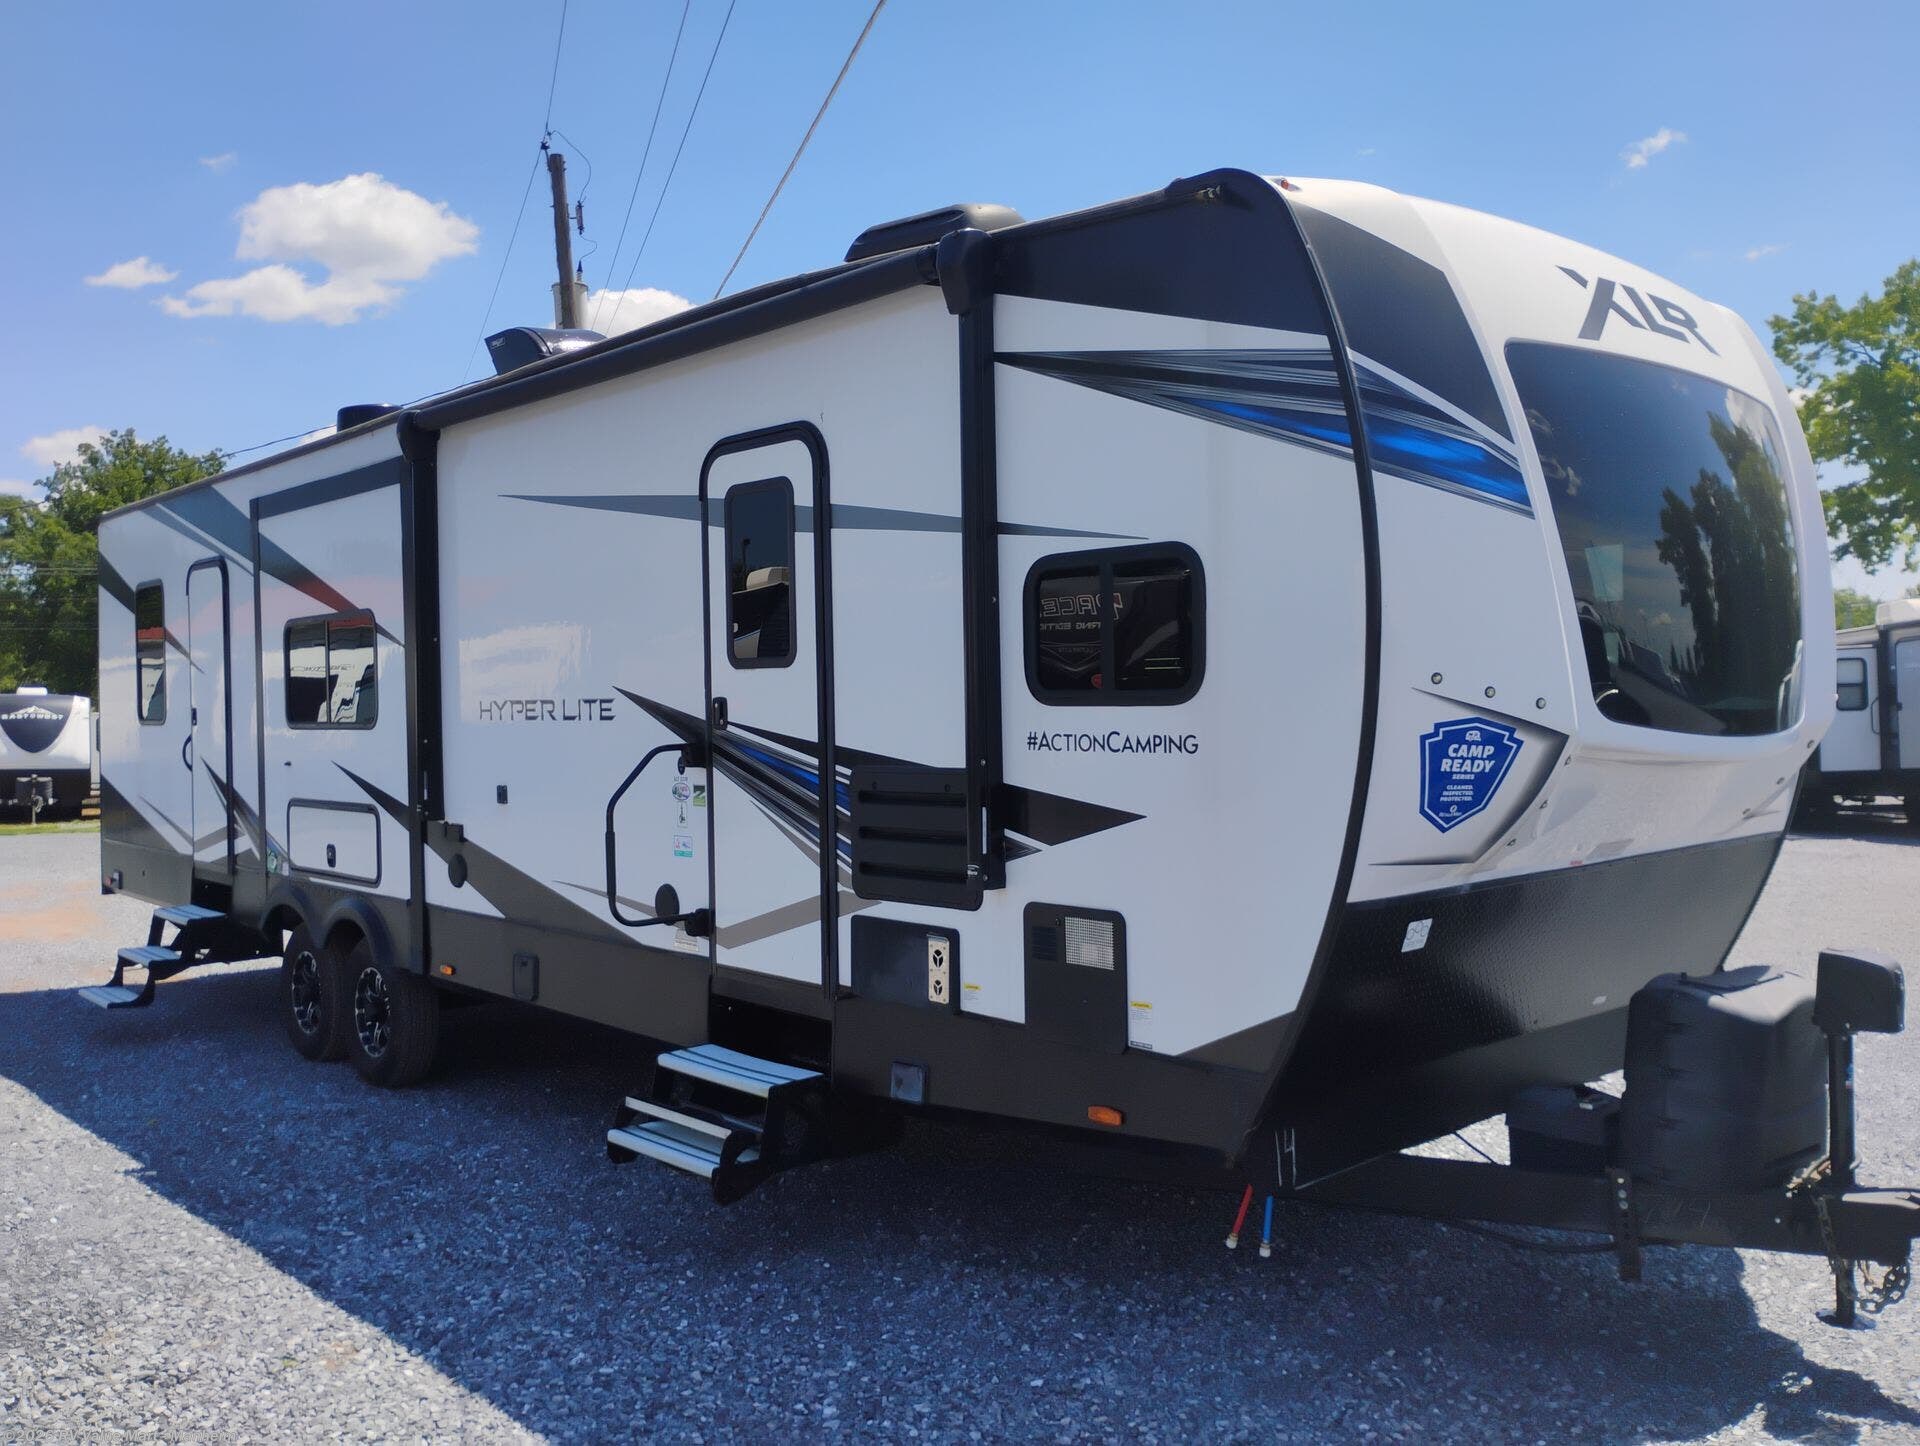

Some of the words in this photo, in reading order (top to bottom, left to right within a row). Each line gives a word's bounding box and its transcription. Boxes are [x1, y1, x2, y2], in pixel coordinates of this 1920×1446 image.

[1555, 265, 1721, 356] XLR
[480, 699, 557, 721] HYPER
[563, 698, 616, 721] LITE
[1447, 743, 1495, 759] CAMP
[1440, 758, 1496, 773] READY
